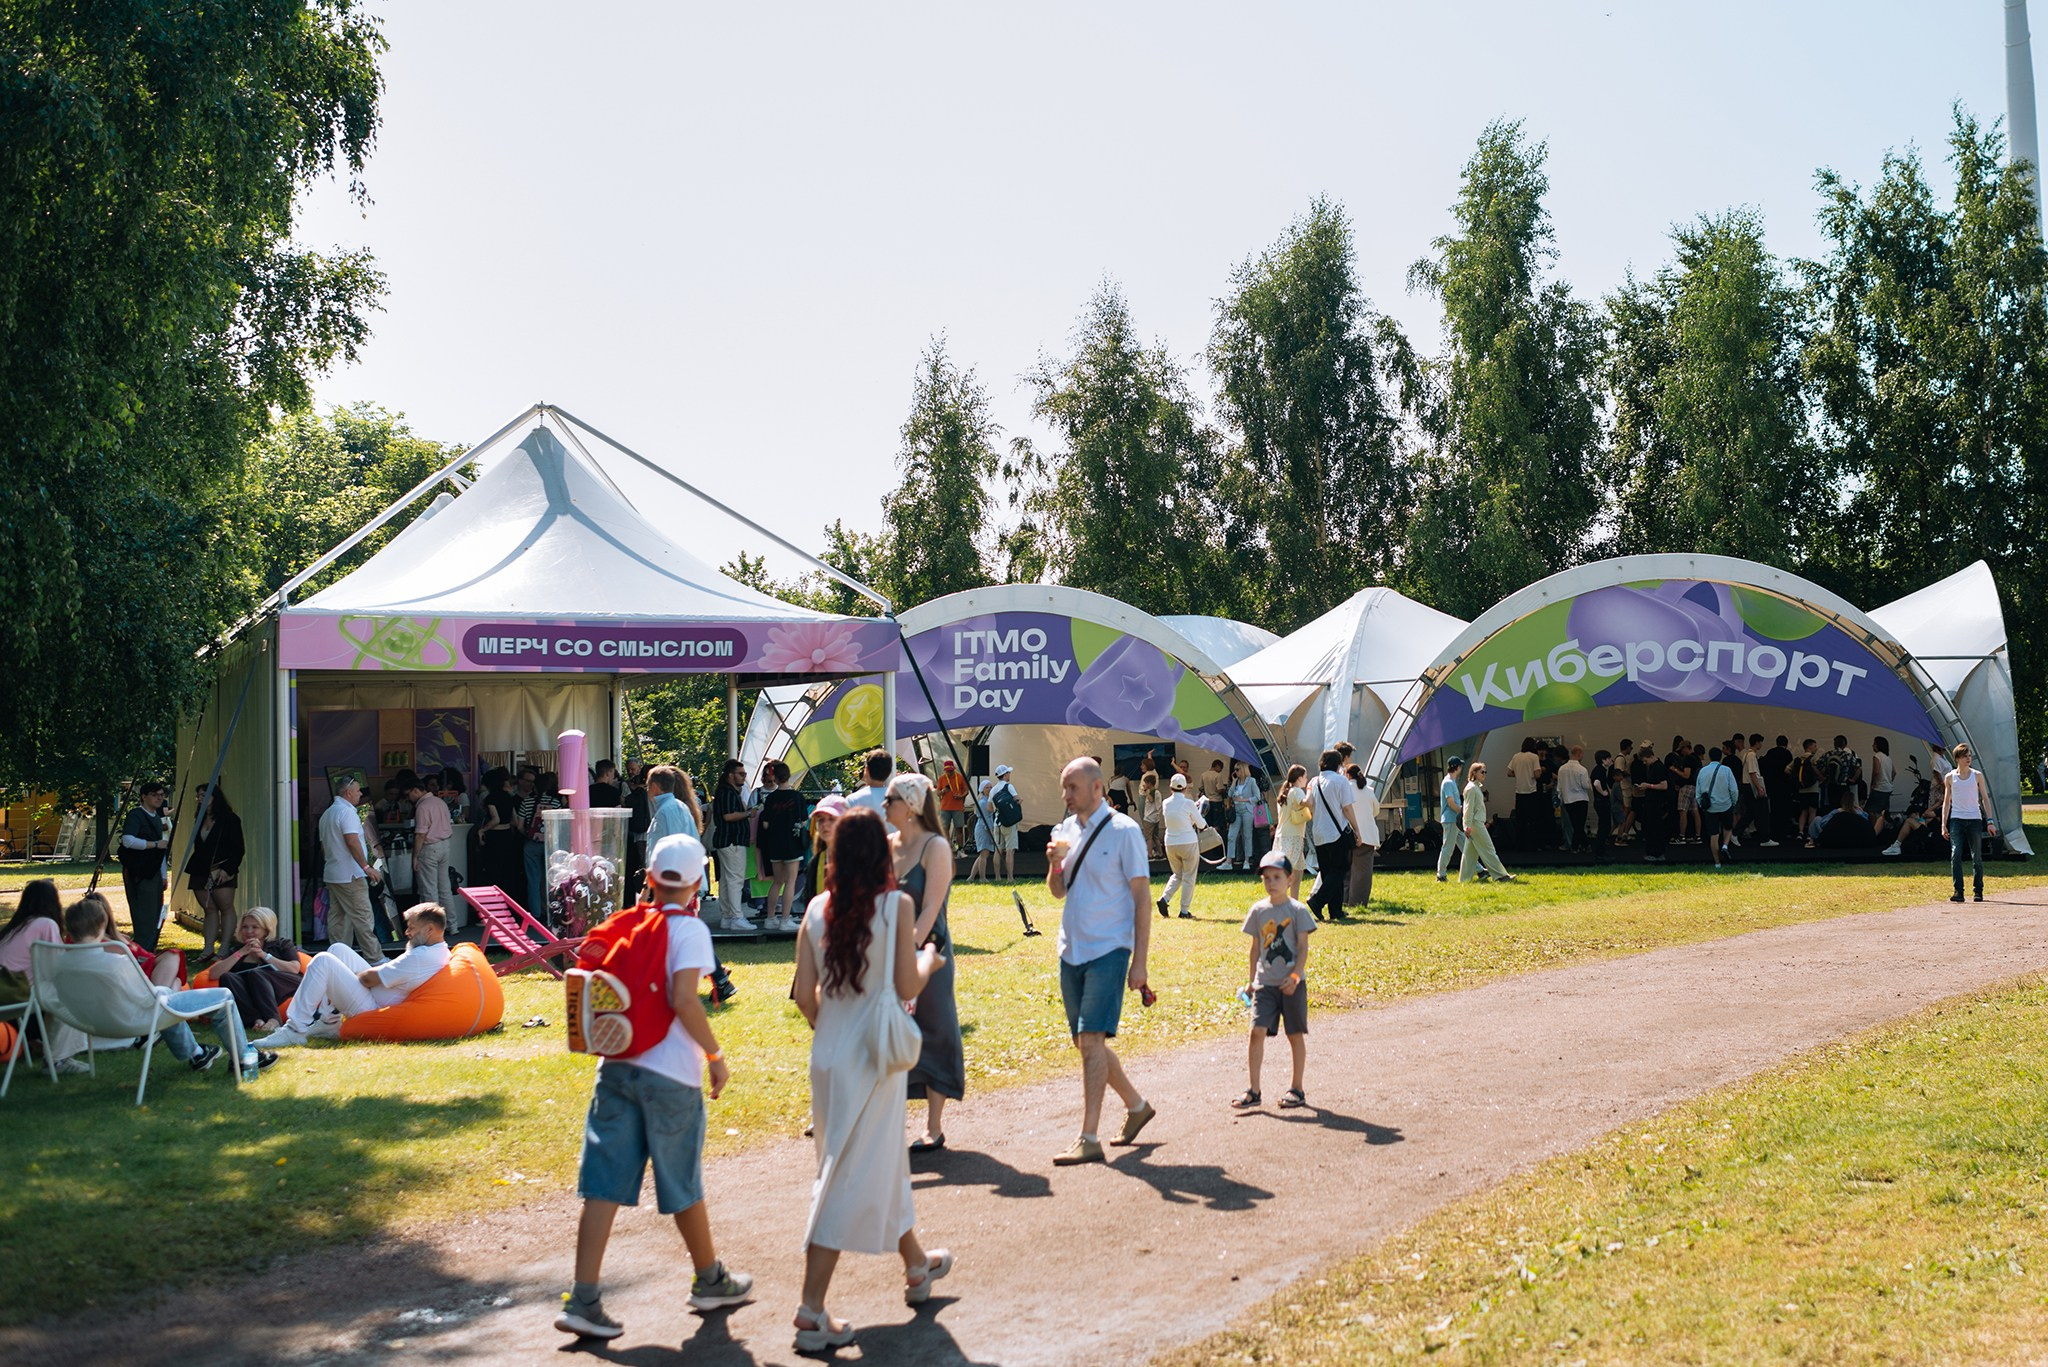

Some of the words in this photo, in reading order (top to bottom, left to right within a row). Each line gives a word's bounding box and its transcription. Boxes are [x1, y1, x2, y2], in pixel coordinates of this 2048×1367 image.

[478, 637, 548, 655] МЕРЧ
[554, 639, 593, 656] СО
[599, 640, 733, 657] СМЫСЛОМ
[954, 628, 1047, 655] ITMO
[954, 653, 1071, 683] Family
[1461, 638, 1867, 713] Киберспорт
[954, 685, 1024, 712] Day
